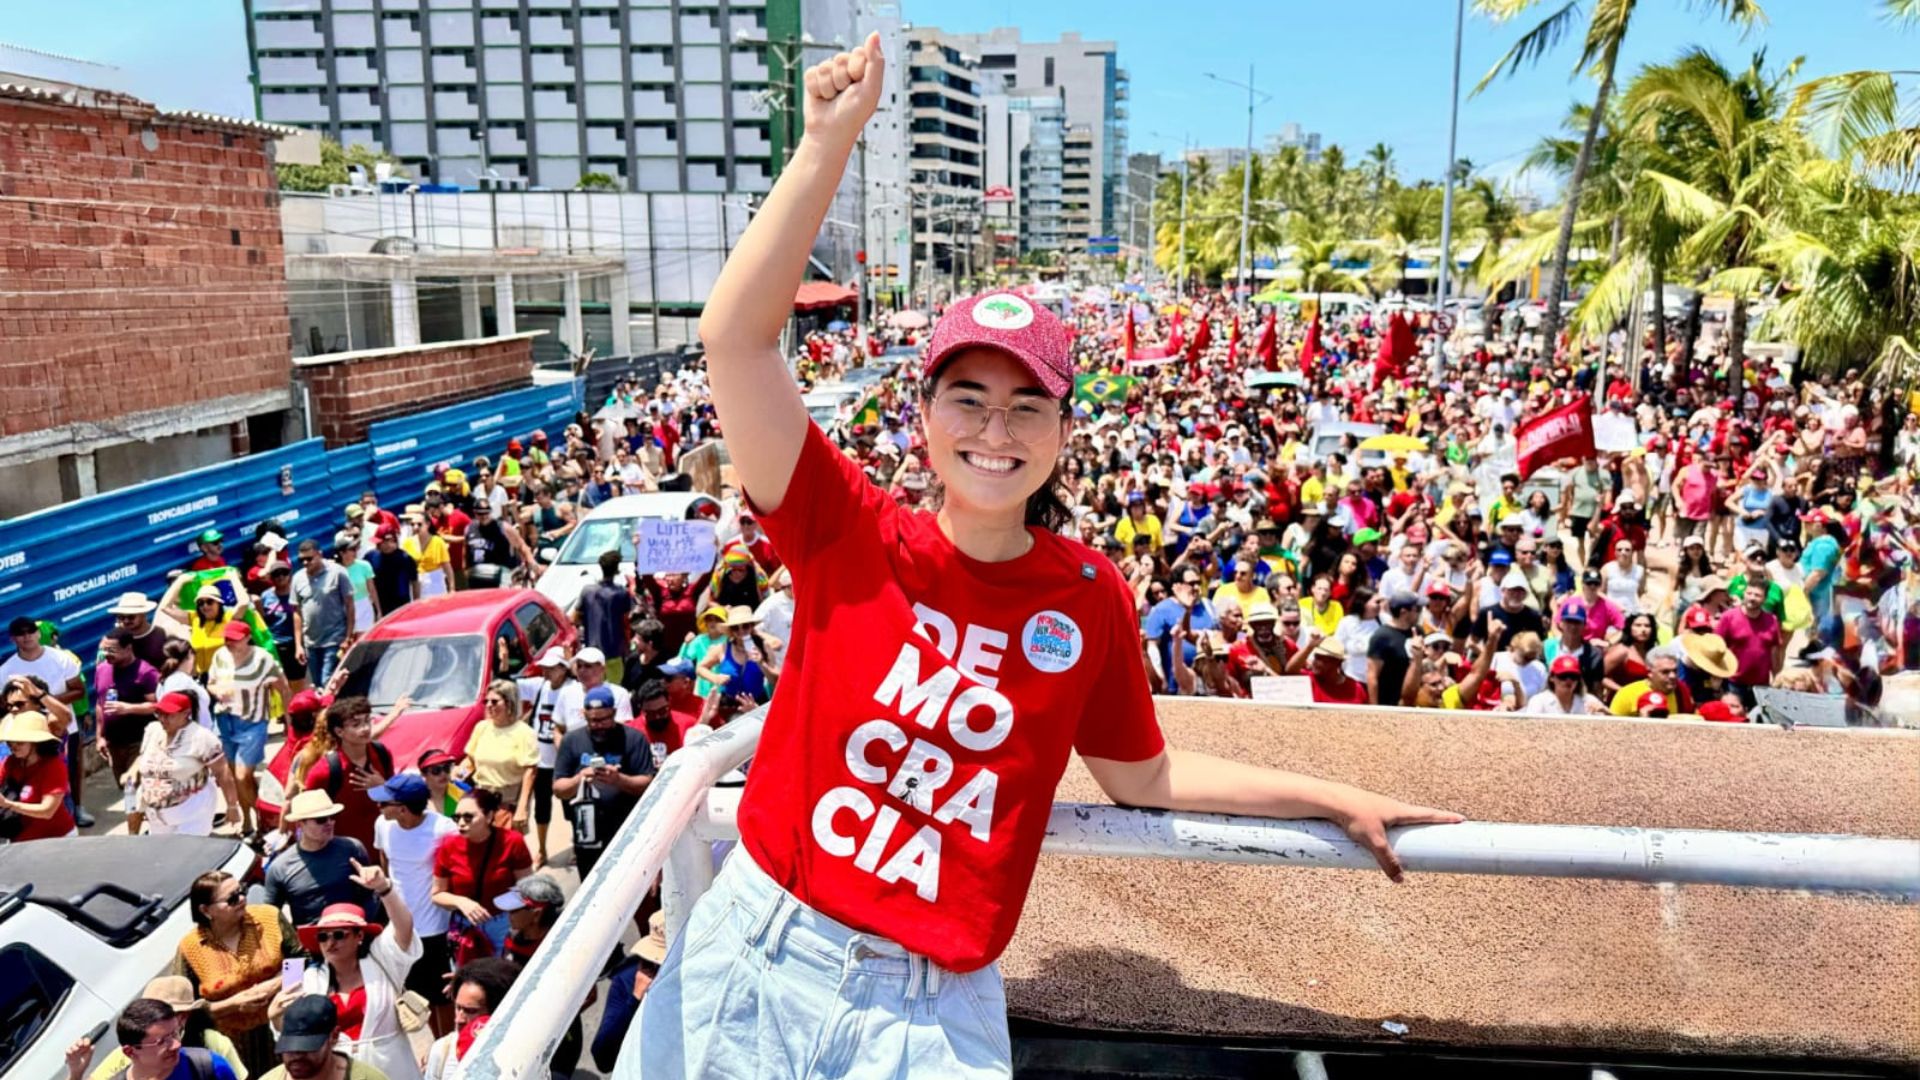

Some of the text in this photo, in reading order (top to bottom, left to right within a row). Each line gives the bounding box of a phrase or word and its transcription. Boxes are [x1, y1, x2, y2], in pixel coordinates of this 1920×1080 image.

[873, 642, 1014, 752] MO
[912, 602, 1009, 690] DE
[845, 719, 999, 843] CRA
[811, 786, 942, 903] CIA
